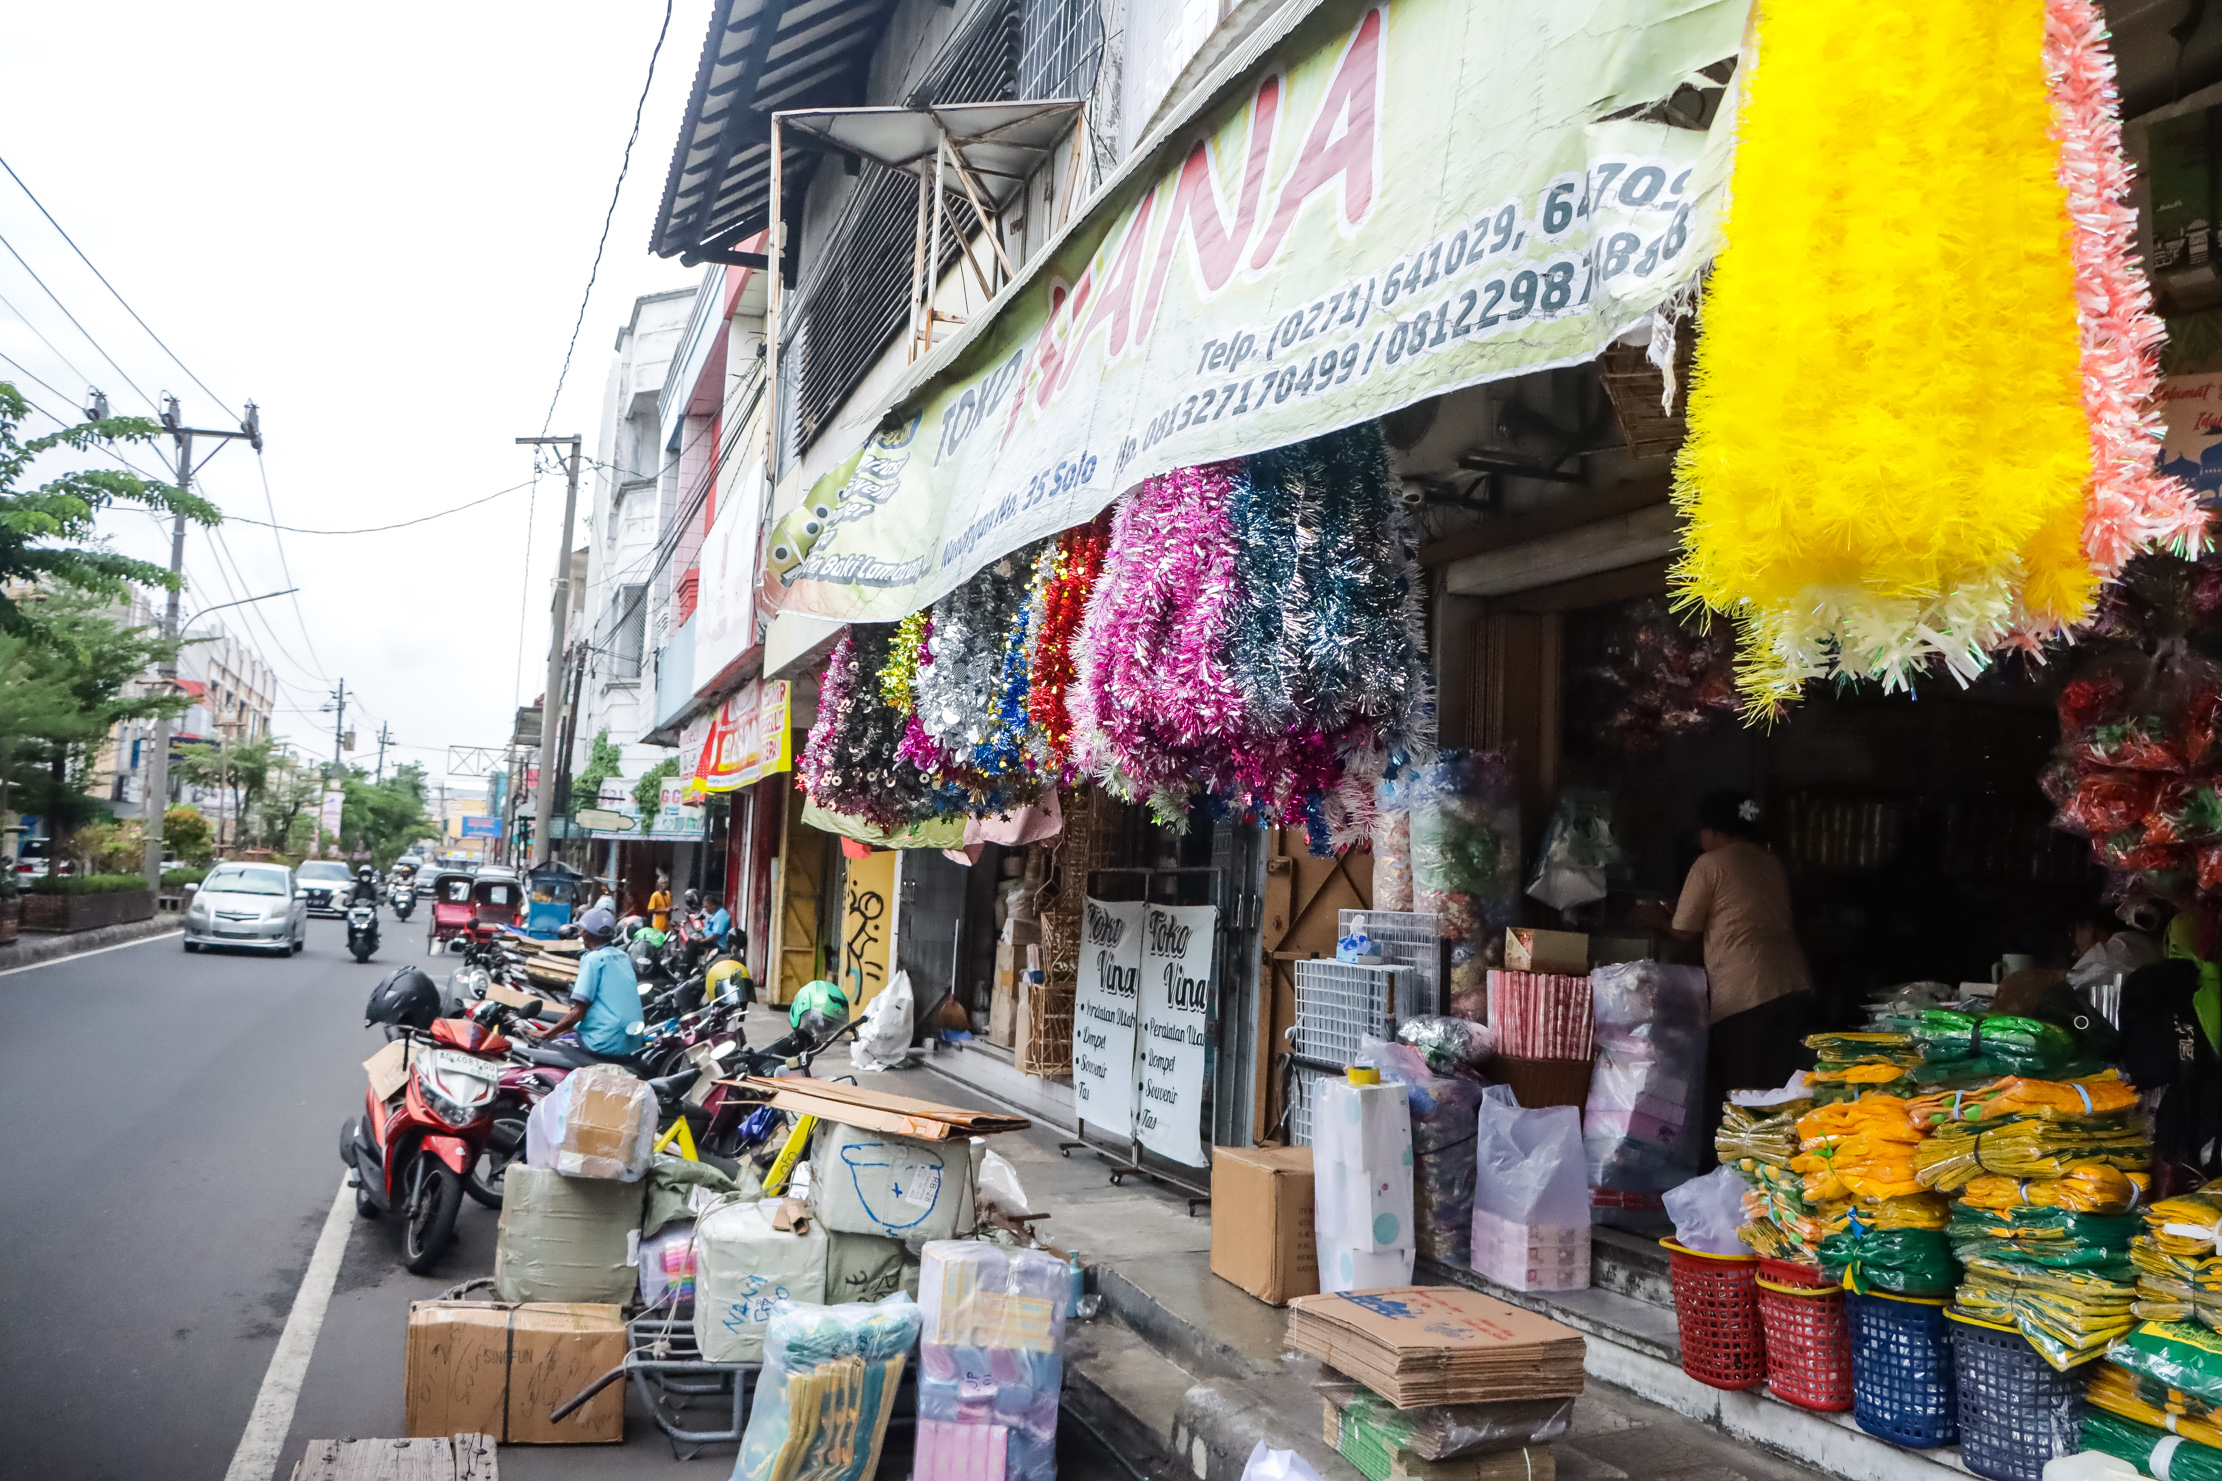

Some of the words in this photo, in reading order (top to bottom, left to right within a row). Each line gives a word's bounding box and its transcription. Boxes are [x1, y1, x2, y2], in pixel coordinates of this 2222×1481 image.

[1196, 329, 1258, 376] Telp.
[1266, 277, 1376, 361] (0271)
[1381, 203, 1526, 307] 641029,
[933, 348, 1024, 467] TOKO
[993, 490, 1018, 528] No.
[1021, 467, 1051, 512] 35
[1048, 449, 1098, 498] Solo
[819, 553, 864, 579] Baki
[1088, 903, 1125, 948] Toko
[1149, 909, 1193, 959] Toko
[1097, 949, 1138, 999] Vina
[1163, 961, 1210, 1015] Vina
[1149, 1016, 1185, 1044] Peralatan
[1148, 1047, 1176, 1076] Dompet
[1079, 1081, 1090, 1101] Tas
[1145, 1078, 1178, 1105] Souvenir
[1141, 1108, 1157, 1130] Tas
